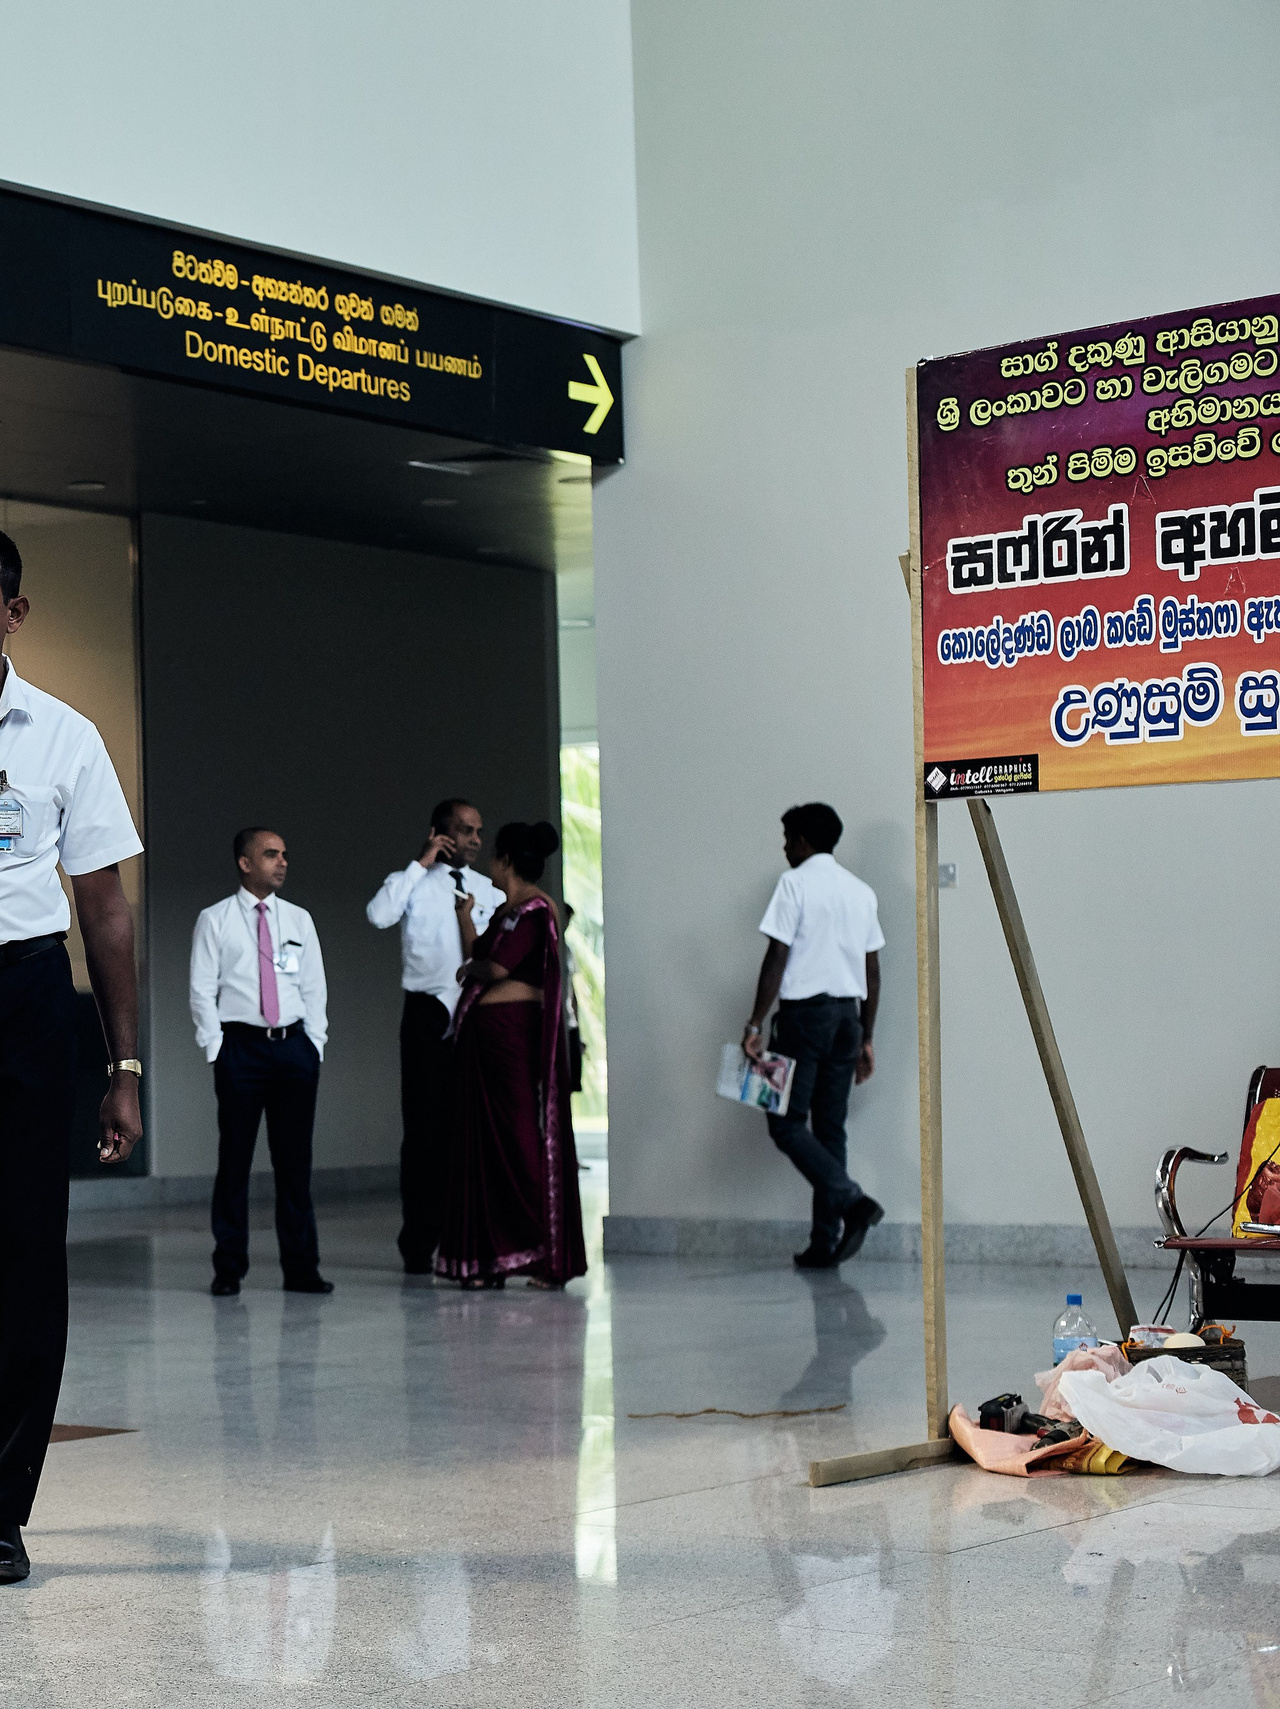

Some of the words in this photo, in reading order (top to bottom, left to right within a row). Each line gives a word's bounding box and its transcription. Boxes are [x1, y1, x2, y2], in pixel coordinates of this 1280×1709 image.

[380, 304, 419, 331] ගමන්
[186, 332, 291, 375] Domestic
[297, 354, 411, 402] Departures
[332, 329, 409, 364] விமானப்
[415, 350, 482, 379] பயணம்
[1000, 342, 1058, 378] සාග්
[969, 378, 1086, 426] ලංකාවට
[1095, 376, 1133, 400] හා
[1143, 350, 1278, 393] වැලිගමට
[1007, 454, 1058, 493] තුන්
[1055, 667, 1220, 742] උණුසුම්
[994, 763, 1032, 775] GRAPHICS
